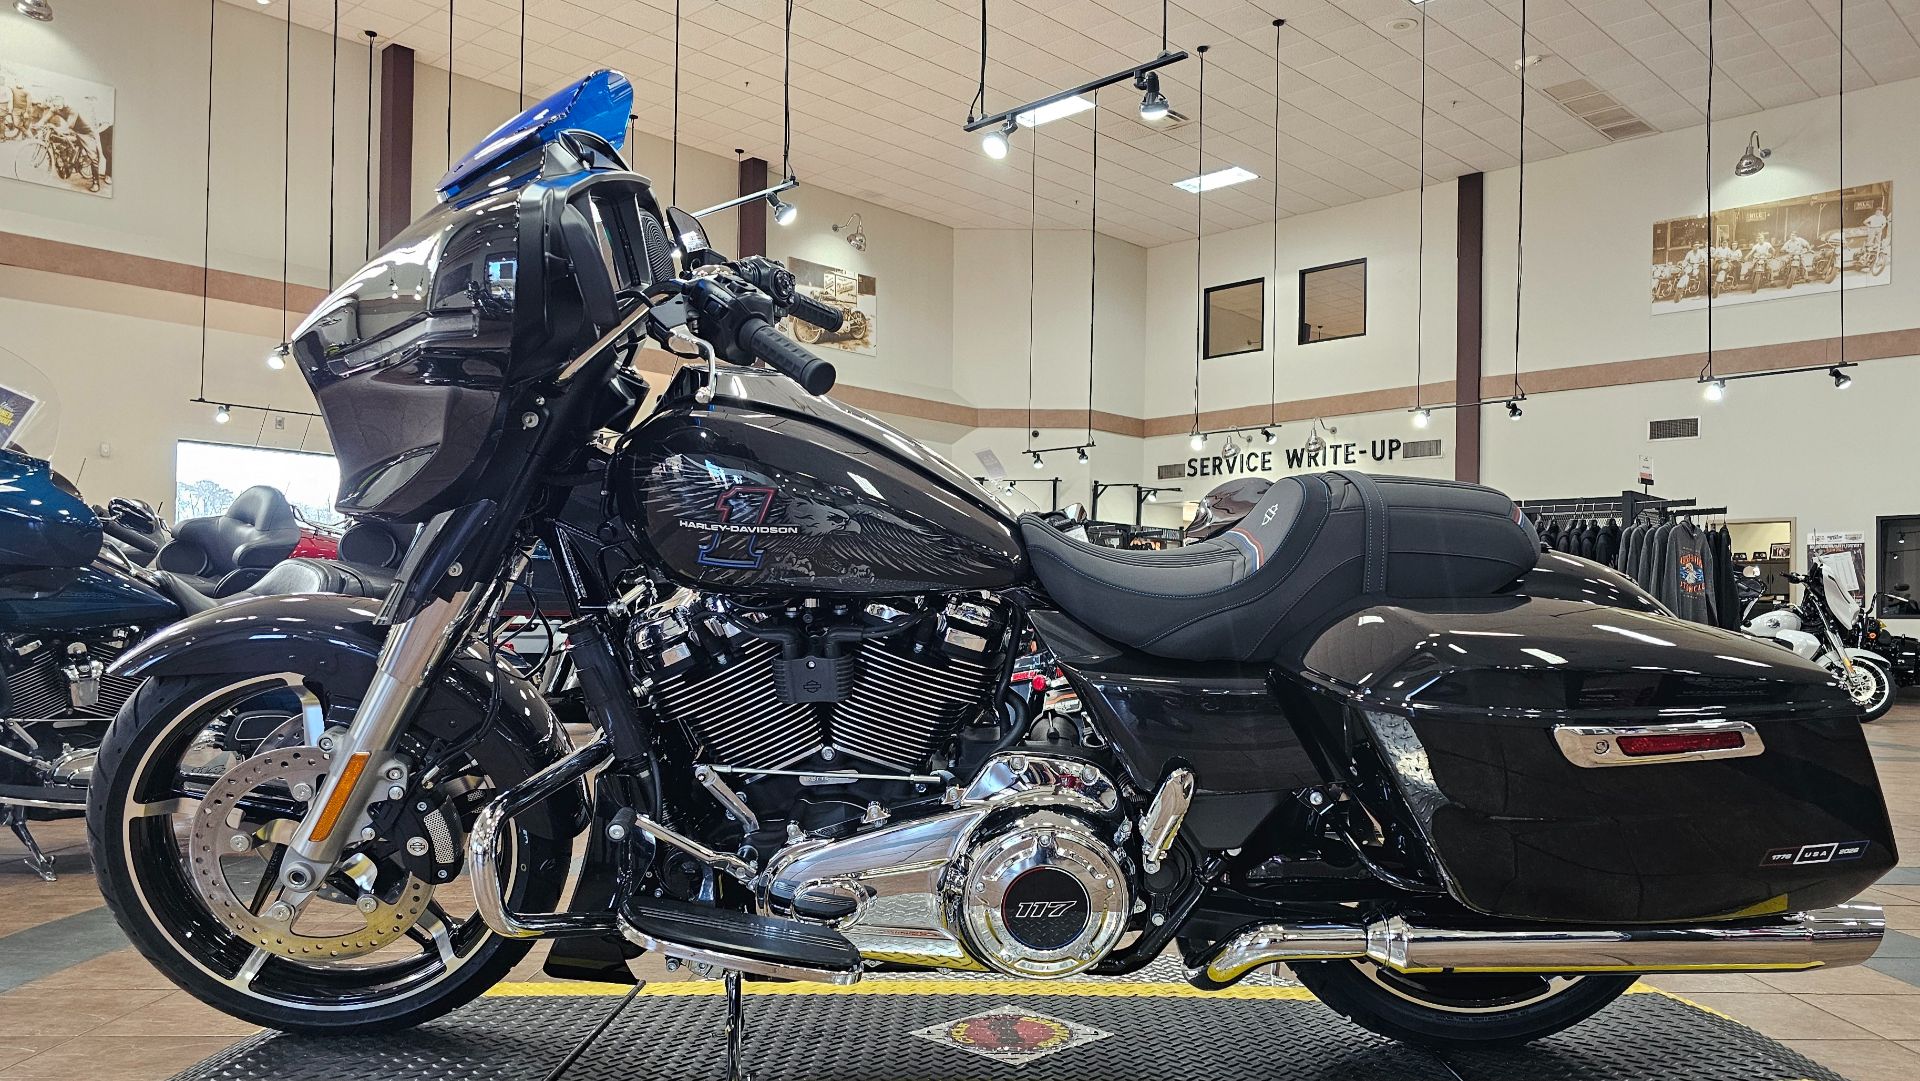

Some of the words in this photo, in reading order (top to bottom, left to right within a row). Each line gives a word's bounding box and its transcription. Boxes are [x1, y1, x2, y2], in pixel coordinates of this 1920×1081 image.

[1187, 451, 1272, 477] SERVICE
[1286, 439, 1401, 469] WRITE-UP
[679, 519, 799, 535] HARLEY-DAVIDSON
[1771, 853, 1793, 861] 1776
[1838, 847, 1861, 855] 2026
[1015, 900, 1078, 918] 117
